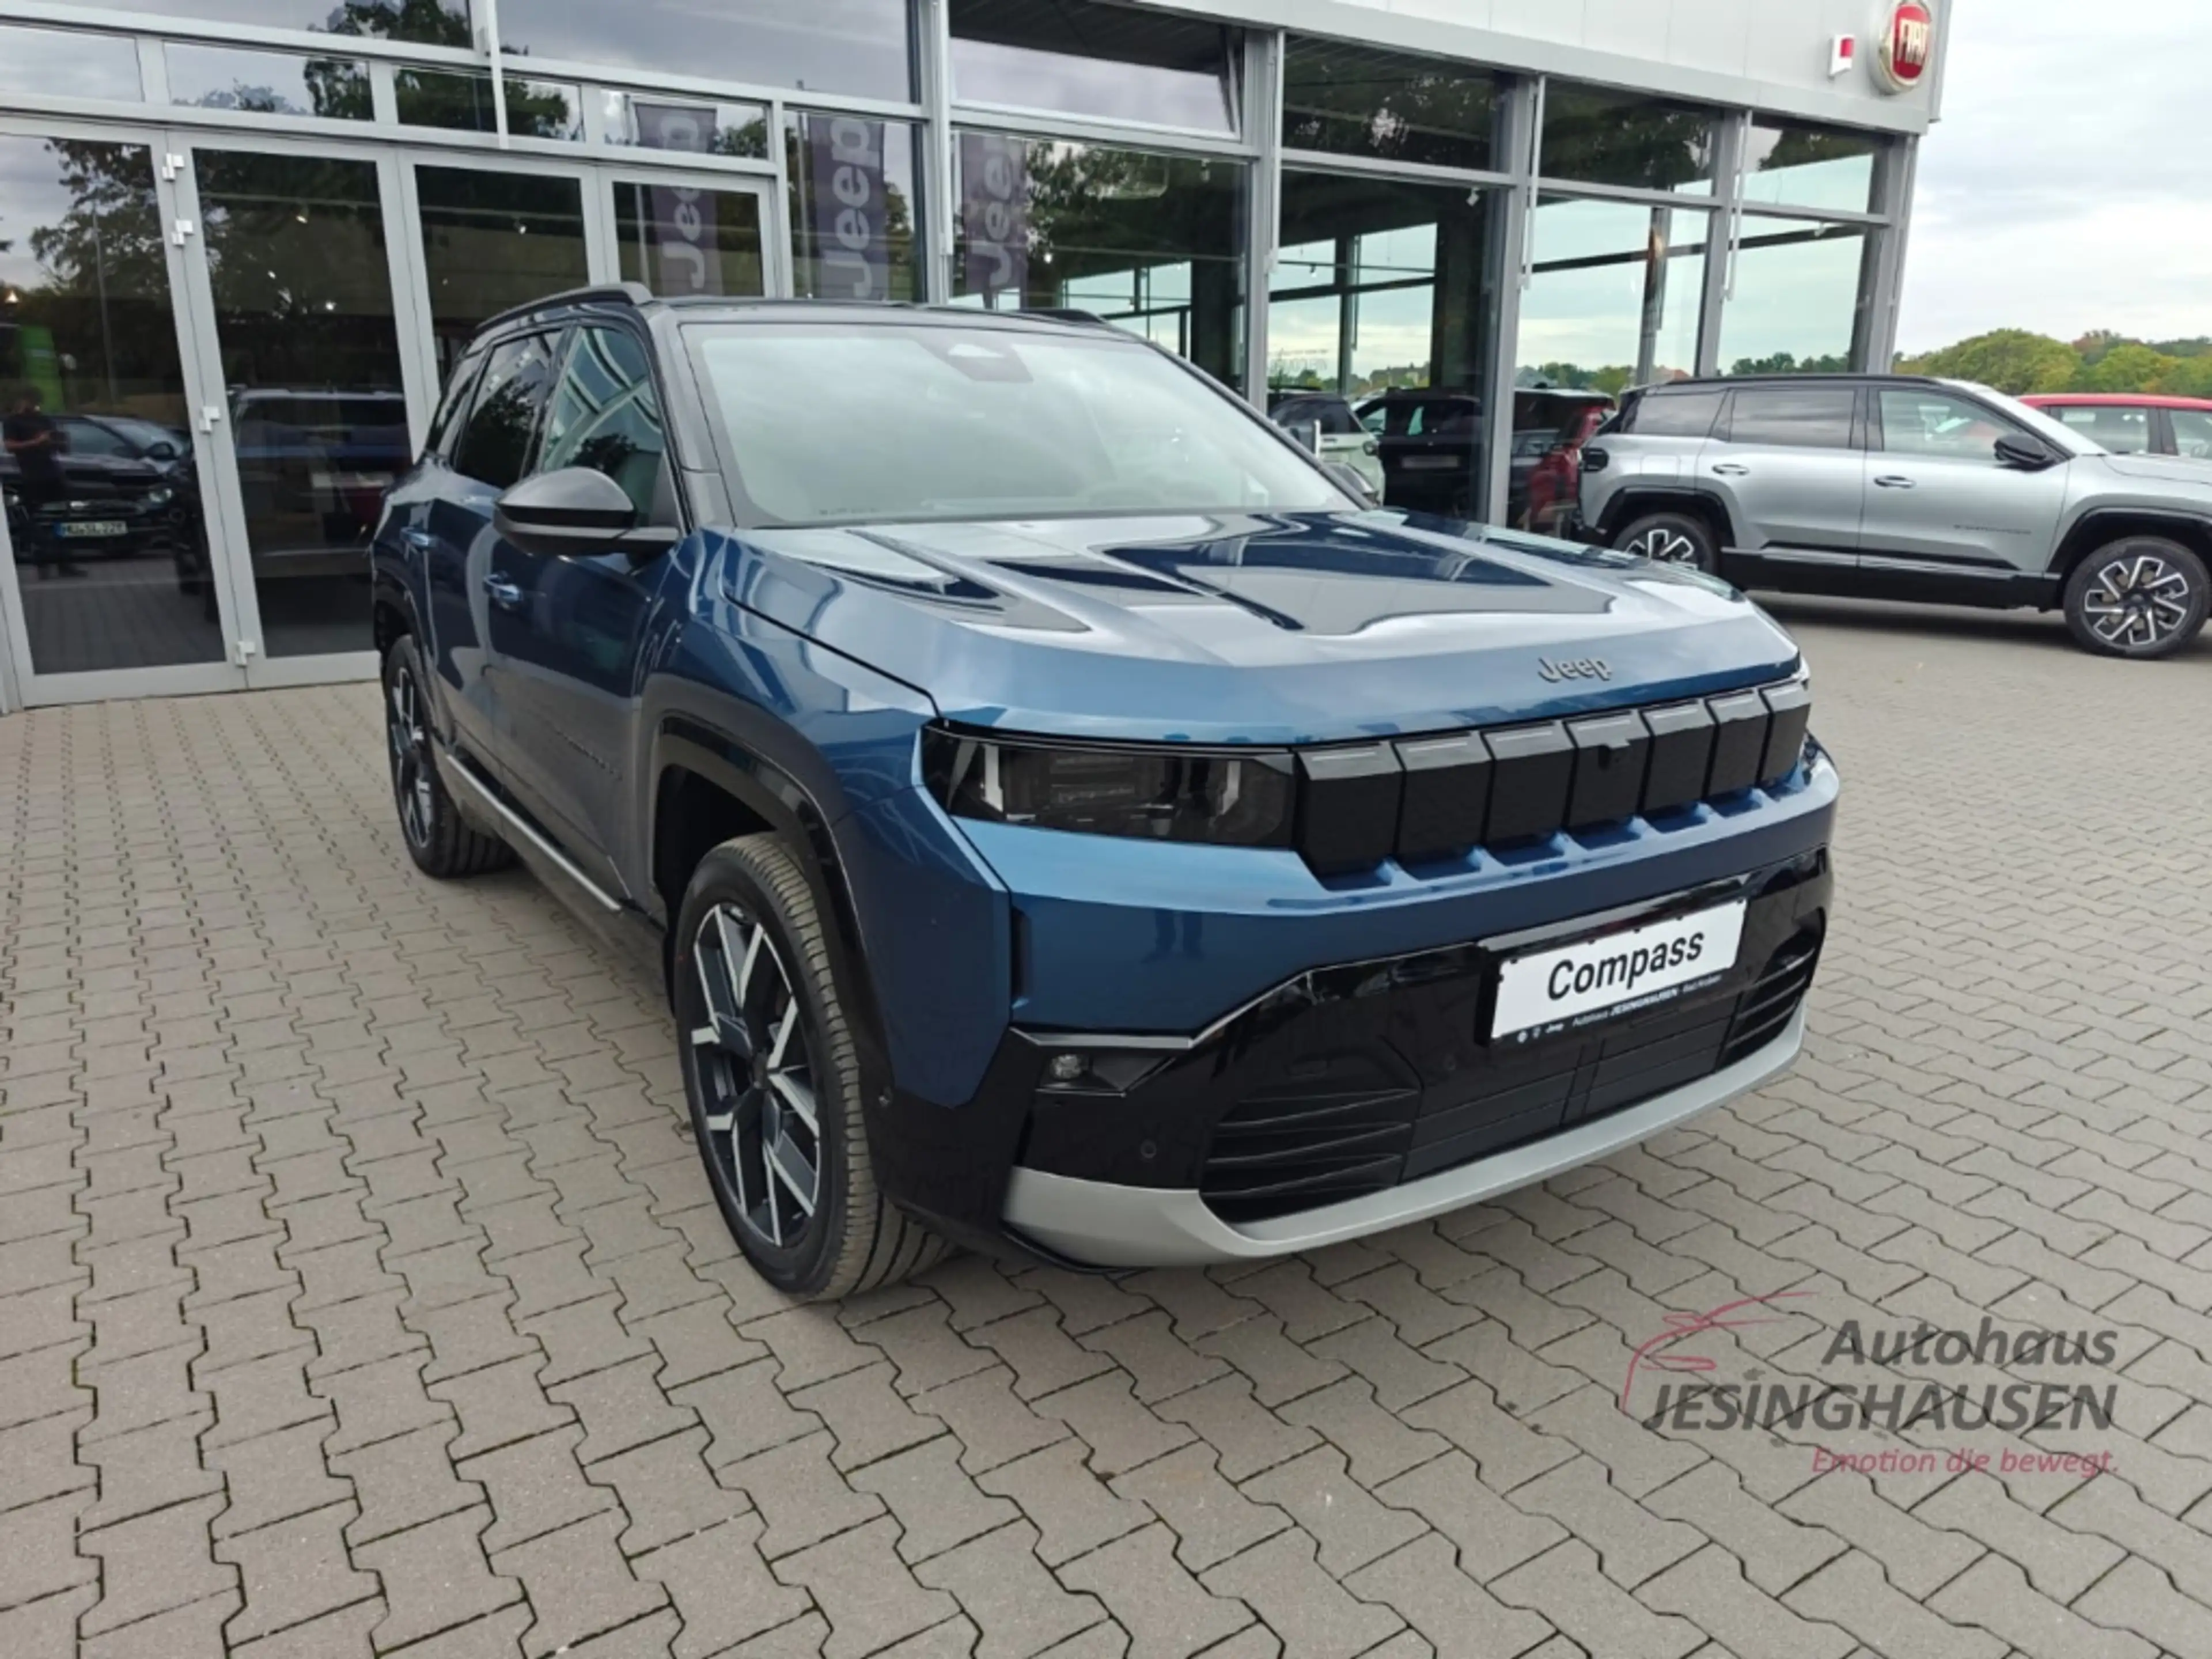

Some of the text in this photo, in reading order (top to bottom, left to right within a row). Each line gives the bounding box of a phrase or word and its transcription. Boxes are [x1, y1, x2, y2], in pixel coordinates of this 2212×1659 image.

[660, 115, 706, 289] Jep
[825, 116, 880, 298] Jeep
[971, 137, 1013, 287] Jee
[1537, 657, 1612, 684] Jeep
[1547, 931, 1705, 1001] Compass
